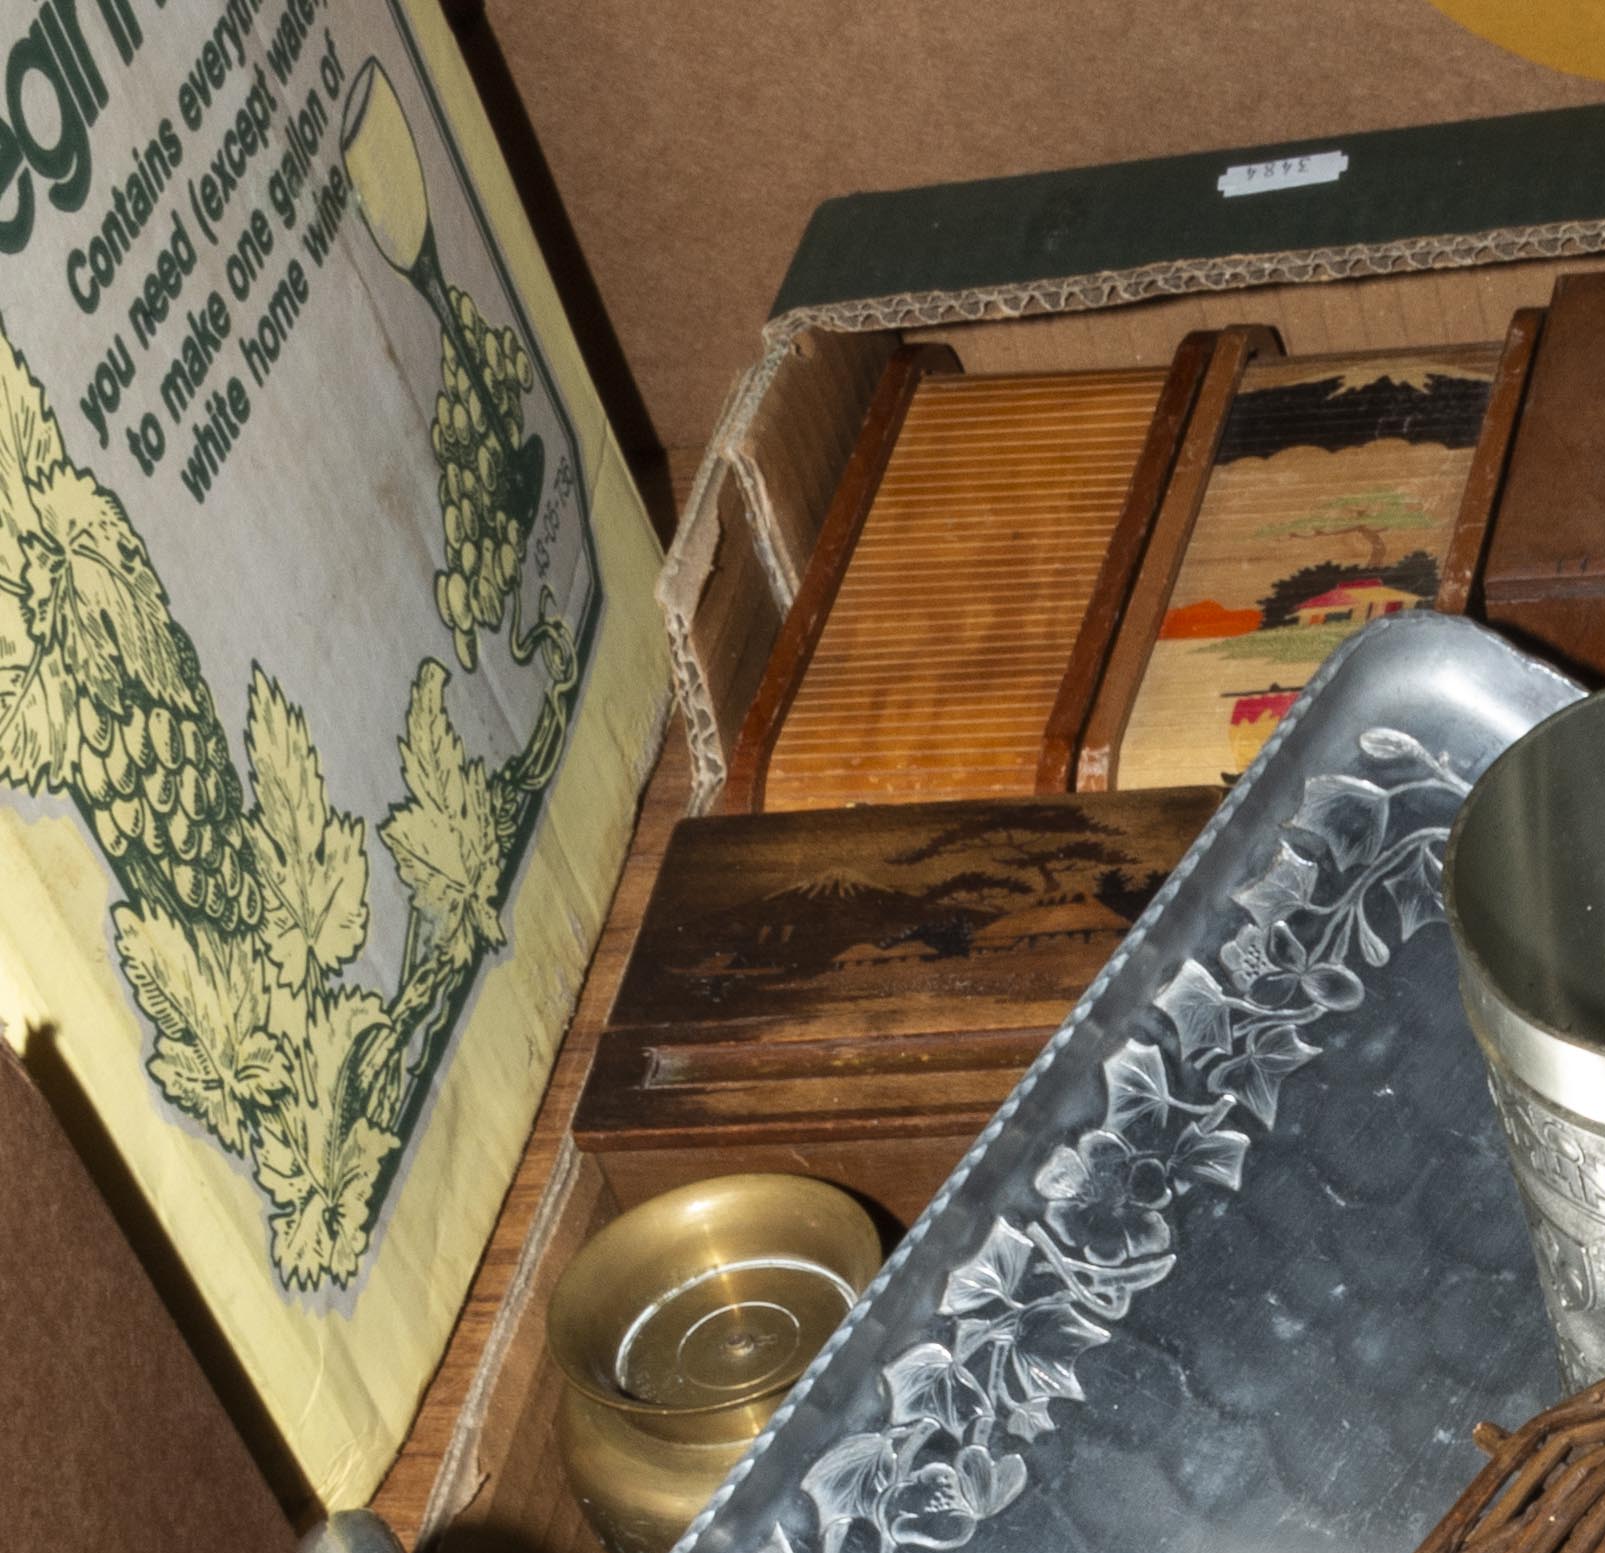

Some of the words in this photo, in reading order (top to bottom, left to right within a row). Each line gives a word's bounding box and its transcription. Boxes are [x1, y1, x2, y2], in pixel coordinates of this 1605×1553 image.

[67, 118, 183, 314] Contains
[80, 333, 136, 450] you
[128, 209, 197, 350] need
[188, 62, 277, 245] (except
[126, 412, 166, 477] to
[161, 291, 231, 424] make
[226, 208, 274, 301] one
[268, 88, 328, 230] gallon
[320, 27, 346, 100] of
[181, 376, 251, 504] white
[239, 258, 309, 388] home
[303, 164, 348, 268] wine
